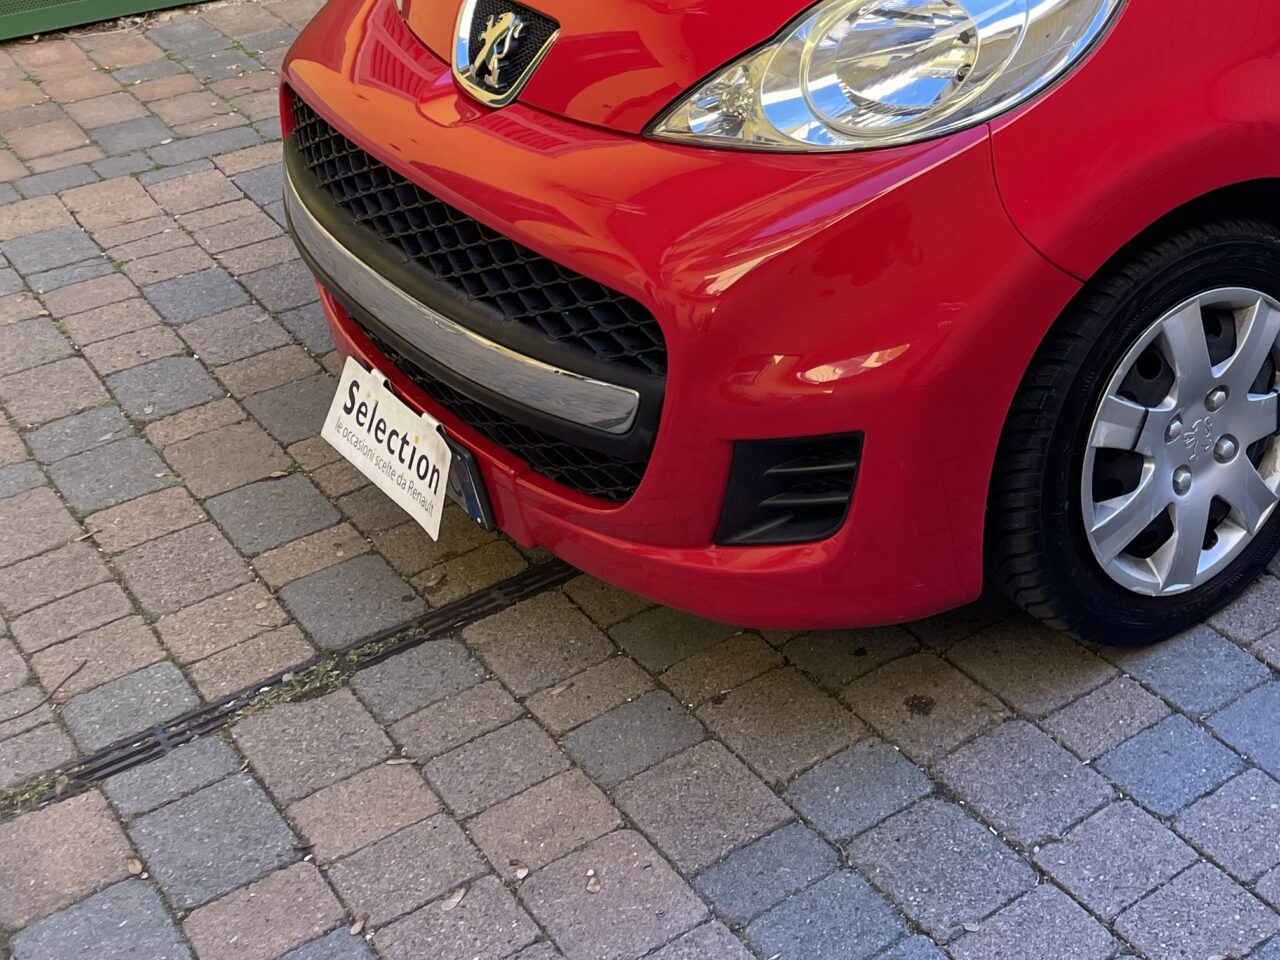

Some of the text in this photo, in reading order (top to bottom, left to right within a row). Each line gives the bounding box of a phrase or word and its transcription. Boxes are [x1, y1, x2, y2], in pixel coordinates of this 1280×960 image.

[334, 416, 434, 518] le occasioni scelte da Renault
[342, 379, 441, 495] Selection
